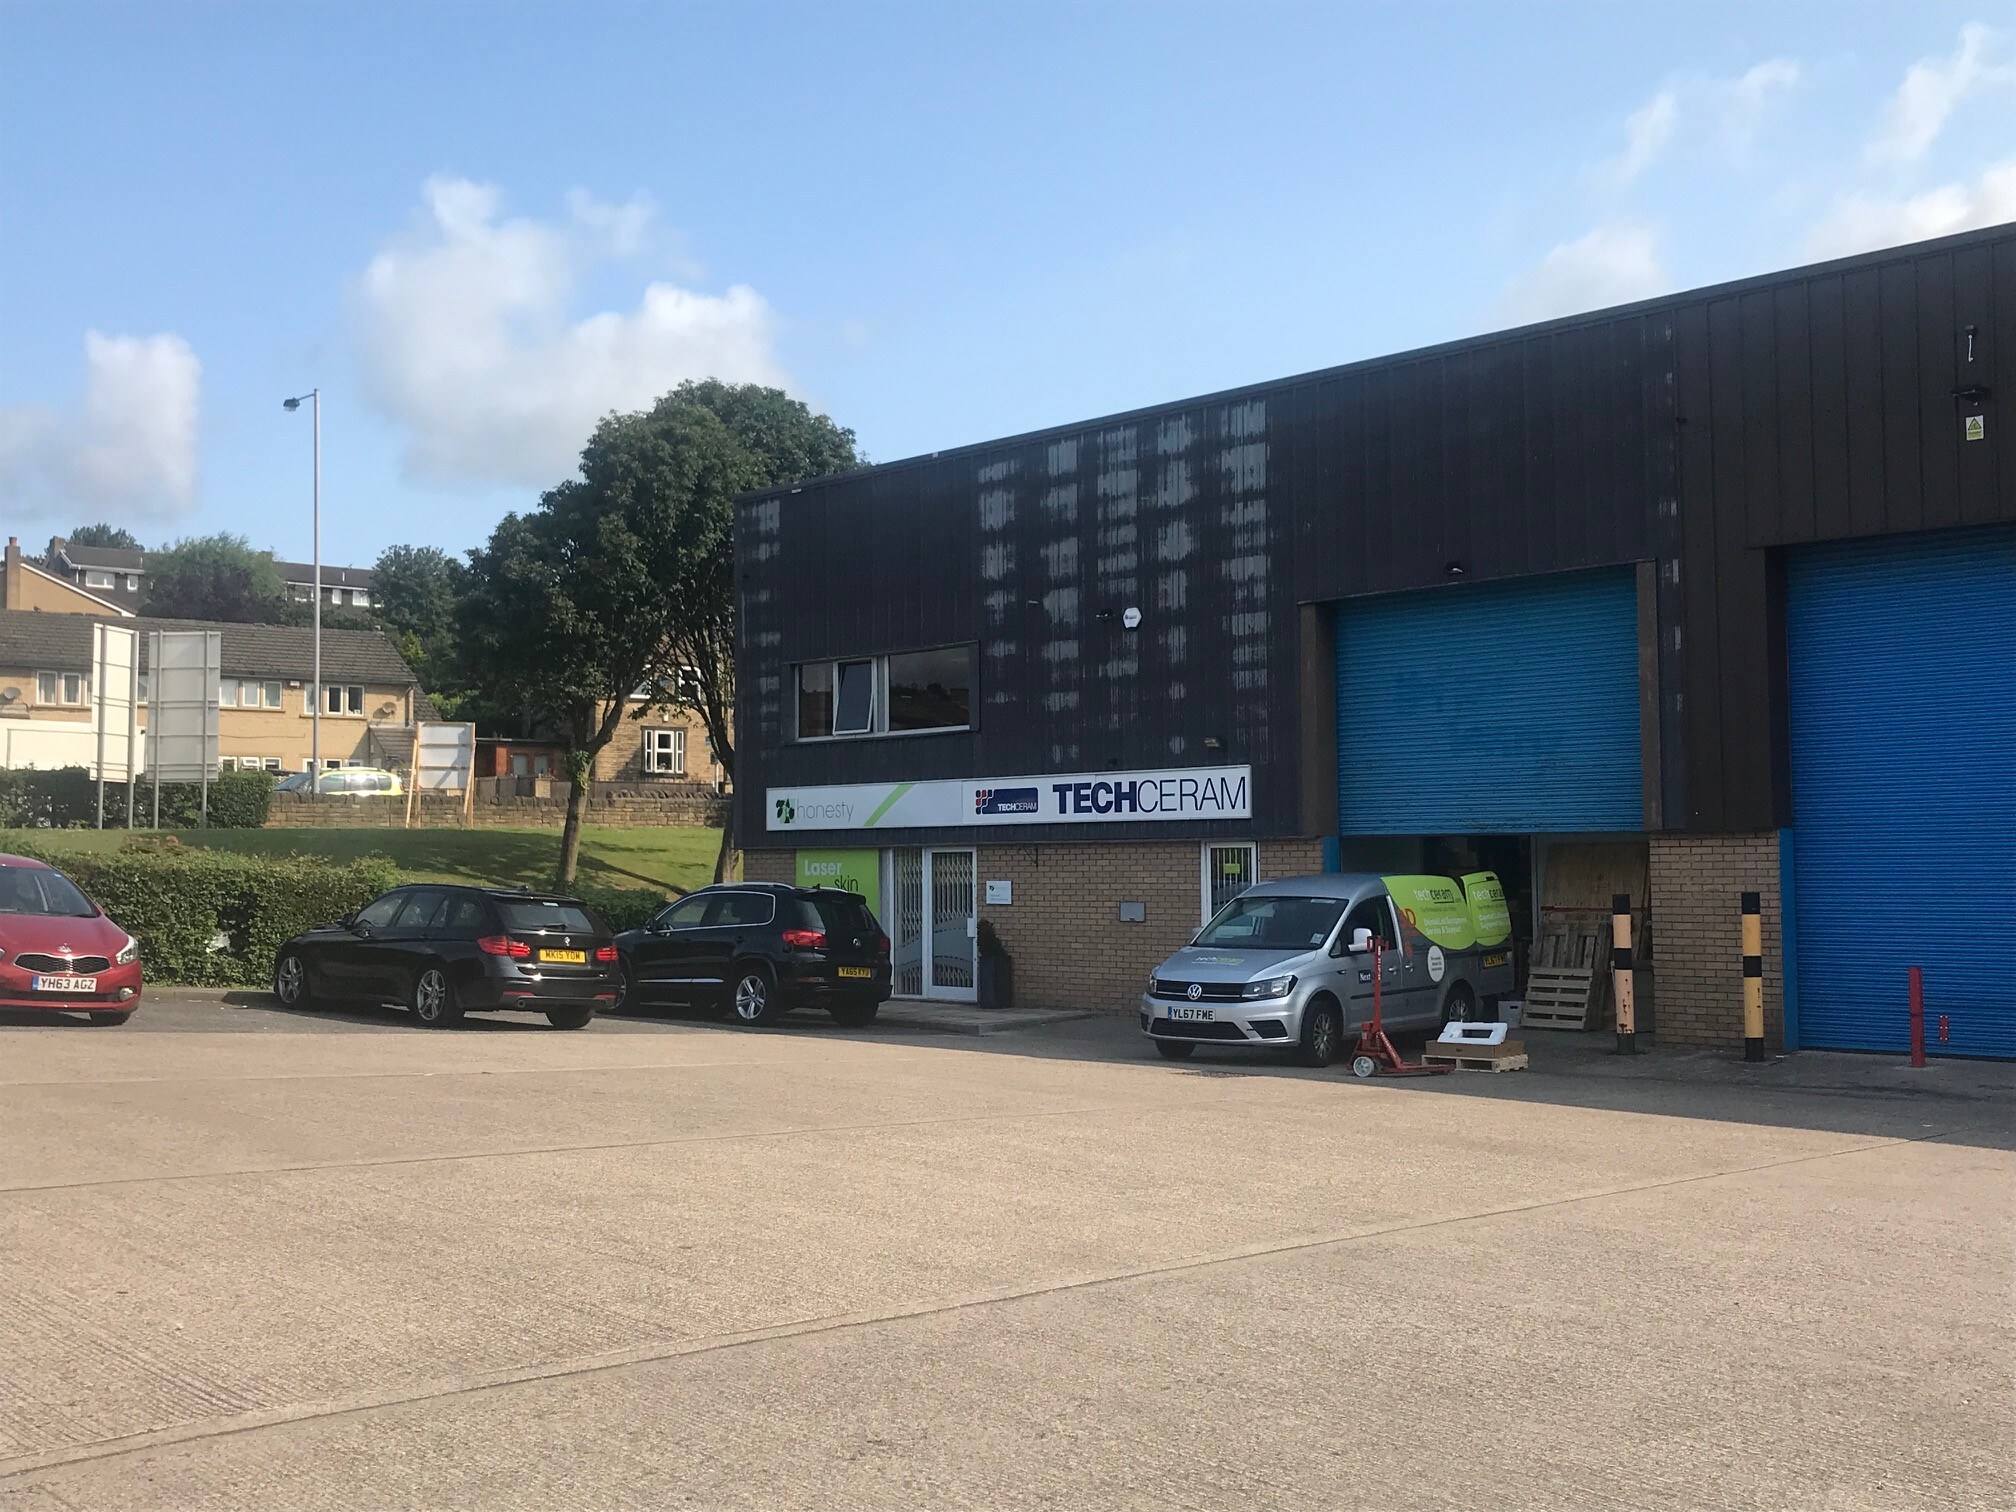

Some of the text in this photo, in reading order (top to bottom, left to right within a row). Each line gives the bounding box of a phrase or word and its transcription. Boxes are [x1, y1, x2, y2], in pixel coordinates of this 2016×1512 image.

[1052, 776, 1247, 815] TECHCERAM
[796, 797, 854, 822] honesty
[998, 802, 1037, 812] TECHCERAM
[804, 860, 842, 876] Laser
[834, 875, 859, 892] skin
[1413, 888, 1454, 901] techceram
[41, 978, 95, 990] YH63 AGZ
[1173, 1008, 1214, 1021] YL67 FME
